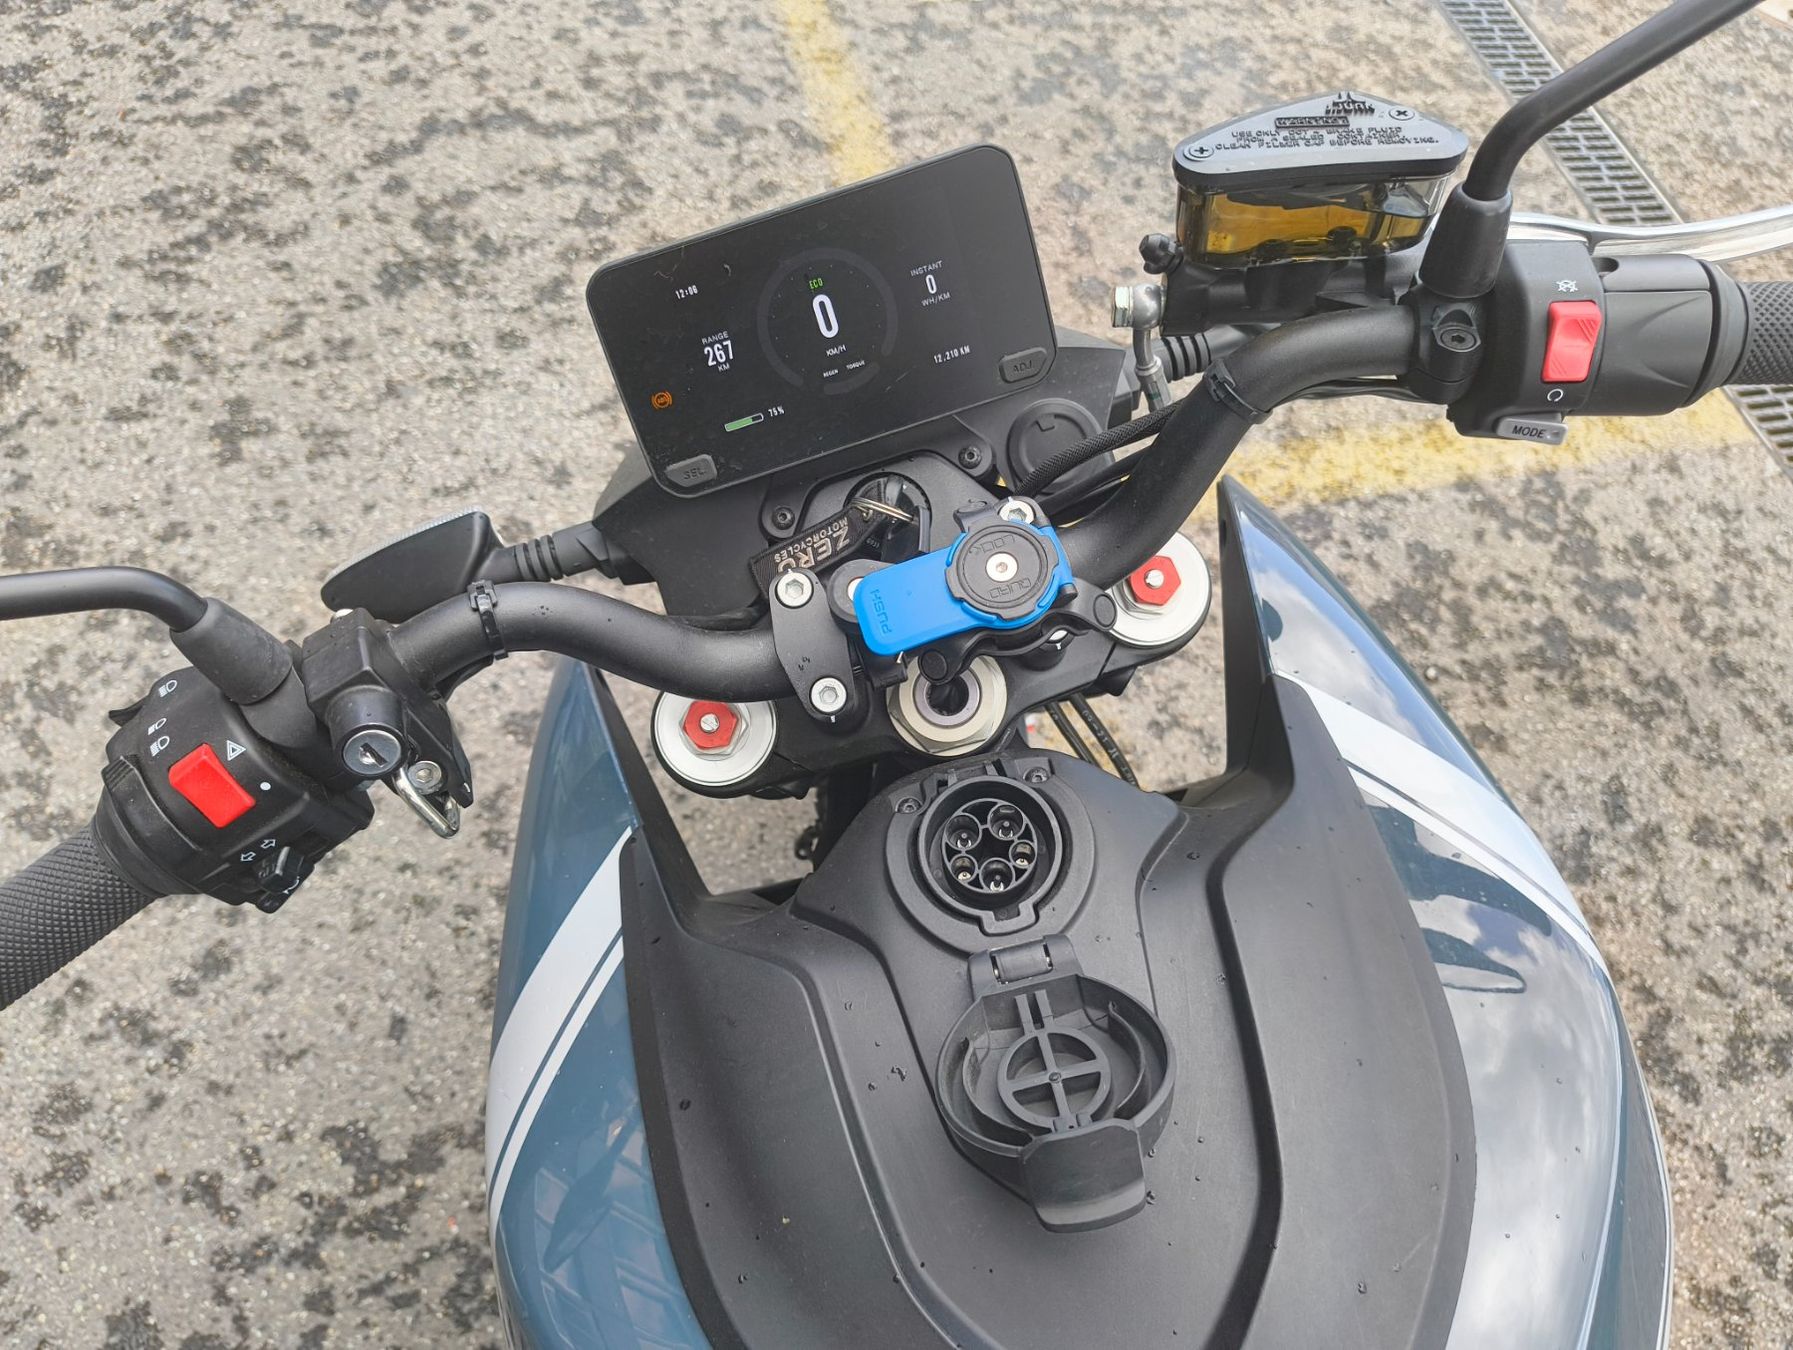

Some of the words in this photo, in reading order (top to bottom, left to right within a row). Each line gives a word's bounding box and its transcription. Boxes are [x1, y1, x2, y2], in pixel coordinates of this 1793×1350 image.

[910, 260, 943, 276] INSTANT
[808, 278, 824, 290] ECO
[926, 274, 937, 294] 0
[812, 294, 839, 338] 0
[701, 330, 729, 345] RANGE
[704, 340, 733, 366] 267
[825, 343, 847, 357] KM/H
[959, 344, 971, 356] KM
[717, 362, 730, 372] KM
[1511, 425, 1547, 438] MODE
[774, 516, 848, 562] MOTORCYCLES
[870, 589, 892, 635] PUSH
